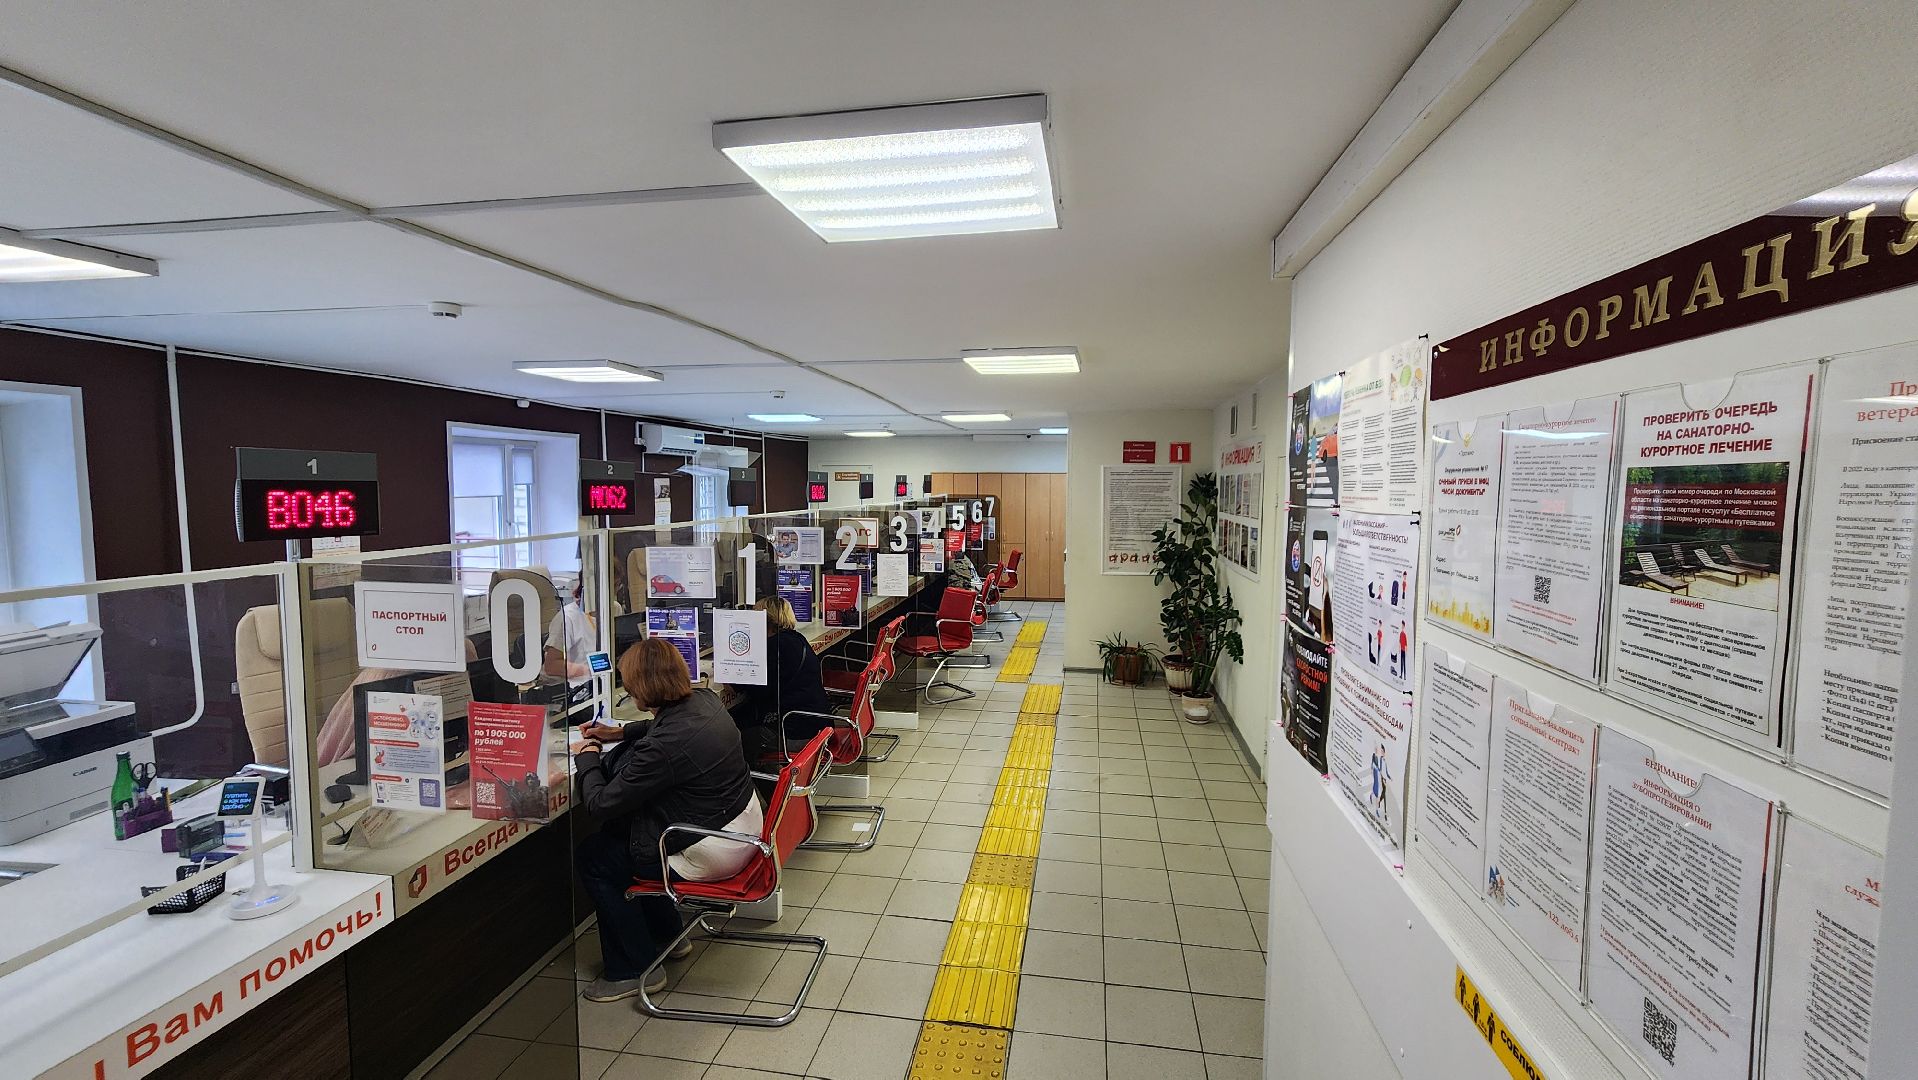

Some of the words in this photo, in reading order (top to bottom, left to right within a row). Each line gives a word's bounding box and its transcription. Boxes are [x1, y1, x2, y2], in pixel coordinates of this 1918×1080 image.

[1643, 409, 1710, 427] ПРОВЕРИТЬ
[1714, 401, 1778, 419] ОЧЕРЕДЬ
[1656, 430, 1672, 441] НА
[1675, 422, 1754, 440] САНАТОРНО-
[1640, 443, 1705, 458] КУРОРТНОЕ
[1708, 439, 1773, 454] ЛЕЧЕНИЕ
[306, 458, 319, 475] 1
[607, 465, 614, 475] 2
[1734, 488, 1776, 496] Московской
[972, 501, 983, 523] 6
[985, 496, 995, 516] 7
[1730, 508, 1776, 517] «Бесплатное
[926, 510, 942, 539] 4
[951, 505, 965, 531] 5
[1663, 515, 1734, 525] санаторно-курортными
[1734, 519, 1776, 527] путевками»
[889, 515, 908, 552] 3
[835, 525, 858, 570] 2
[737, 543, 756, 606] 1
[1669, 597, 1705, 610] ВНИМАНИЕ!
[372, 609, 447, 623] ПАСПОРТНЫЙ
[395, 626, 424, 636] СТОЛ
[490, 578, 543, 684] 0
[1695, 622, 1724, 634] бесплатное
[1731, 646, 1757, 657] (справка
[1716, 668, 1731, 676] после
[1824, 669, 1872, 687] Необходимо
[1712, 674, 1728, 683] также
[1728, 680, 1758, 692] снимается
[1823, 680, 1845, 691] месту
[1703, 696, 1734, 710] социальной
[1827, 689, 1848, 700] Фото
[1826, 697, 1851, 710] Копия
[1852, 706, 1891, 722] паспорта
[1826, 706, 1851, 720] Копия
[1852, 716, 1885, 730] справки
[474, 729, 485, 737] по
[485, 729, 490, 737] 1
[490, 729, 508, 738] 905
[508, 730, 527, 739] 000
[1548, 720, 1585, 744] заключить
[1836, 721, 1852, 729] при
[474, 737, 504, 746] рублей
[1510, 714, 1547, 738] социальный
[1548, 734, 1580, 757] контракт
[1825, 724, 1850, 738] Копия
[1851, 734, 1883, 750] приказа
[1824, 733, 1849, 748] Копия
[1850, 743, 1888, 761] военного
[72, 766, 97, 777] Canon
[1644, 757, 1698, 789] ВНИМАНИЕ!
[1643, 778, 1694, 811] ИНФОРМАЦИЯ
[1694, 805, 1701, 813] О
[1631, 782, 1713, 831] ЗУБОПРОТЕЗИРОВАНИИ
[444, 821, 519, 876] Всегда
[1711, 842, 1742, 864] Московской
[126, 990, 223, 1068] Вам
[239, 892, 381, 1000] помочь!
[1500, 1030, 1541, 1080] СОБЛЮ
